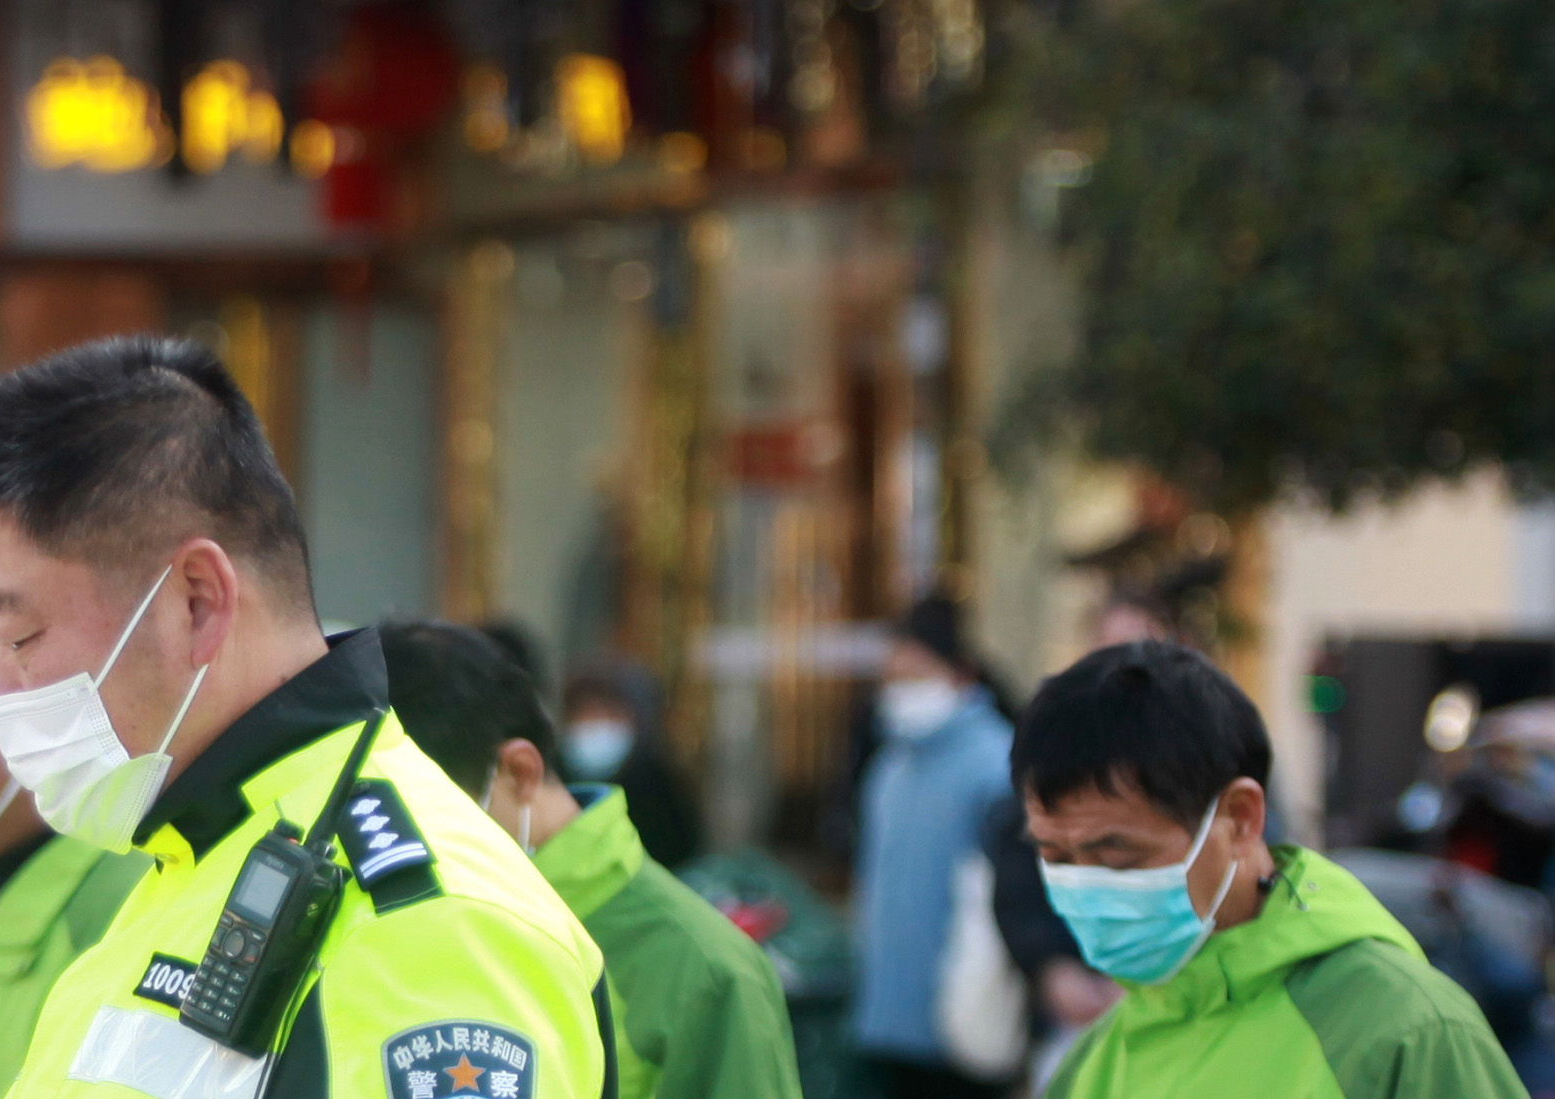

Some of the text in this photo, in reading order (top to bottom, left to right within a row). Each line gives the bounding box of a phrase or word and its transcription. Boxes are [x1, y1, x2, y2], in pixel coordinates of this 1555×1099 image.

[142, 962, 196, 999] 1009
[393, 1027, 527, 1071] 中华人民共和国
